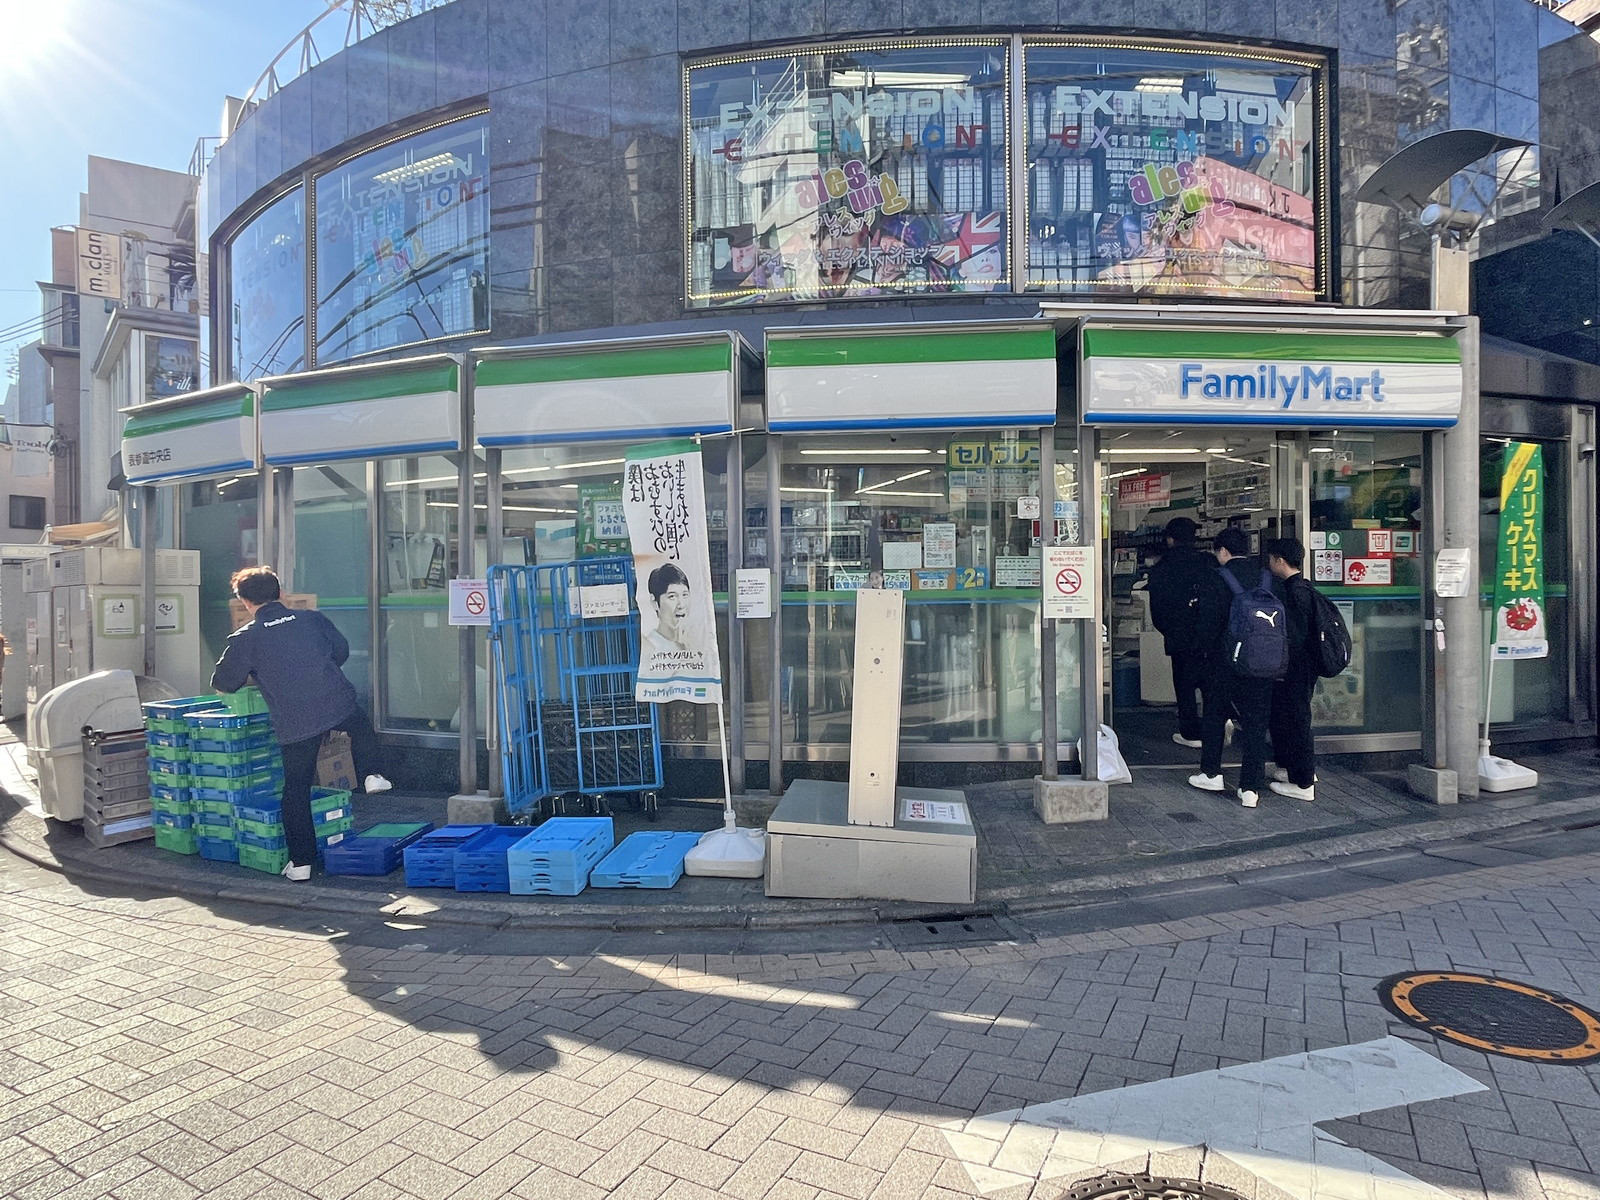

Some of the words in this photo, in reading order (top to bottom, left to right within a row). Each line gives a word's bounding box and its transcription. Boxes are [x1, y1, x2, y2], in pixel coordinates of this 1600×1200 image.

[719, 86, 975, 130] EXTENSION
[1056, 85, 1295, 127] EXTENSION
[1179, 363, 1385, 410] FamilyMart
[128, 448, 171, 467] 表参道中央店
[1521, 469, 1538, 591] クリスマス
[1502, 521, 1523, 592] ケーキ
